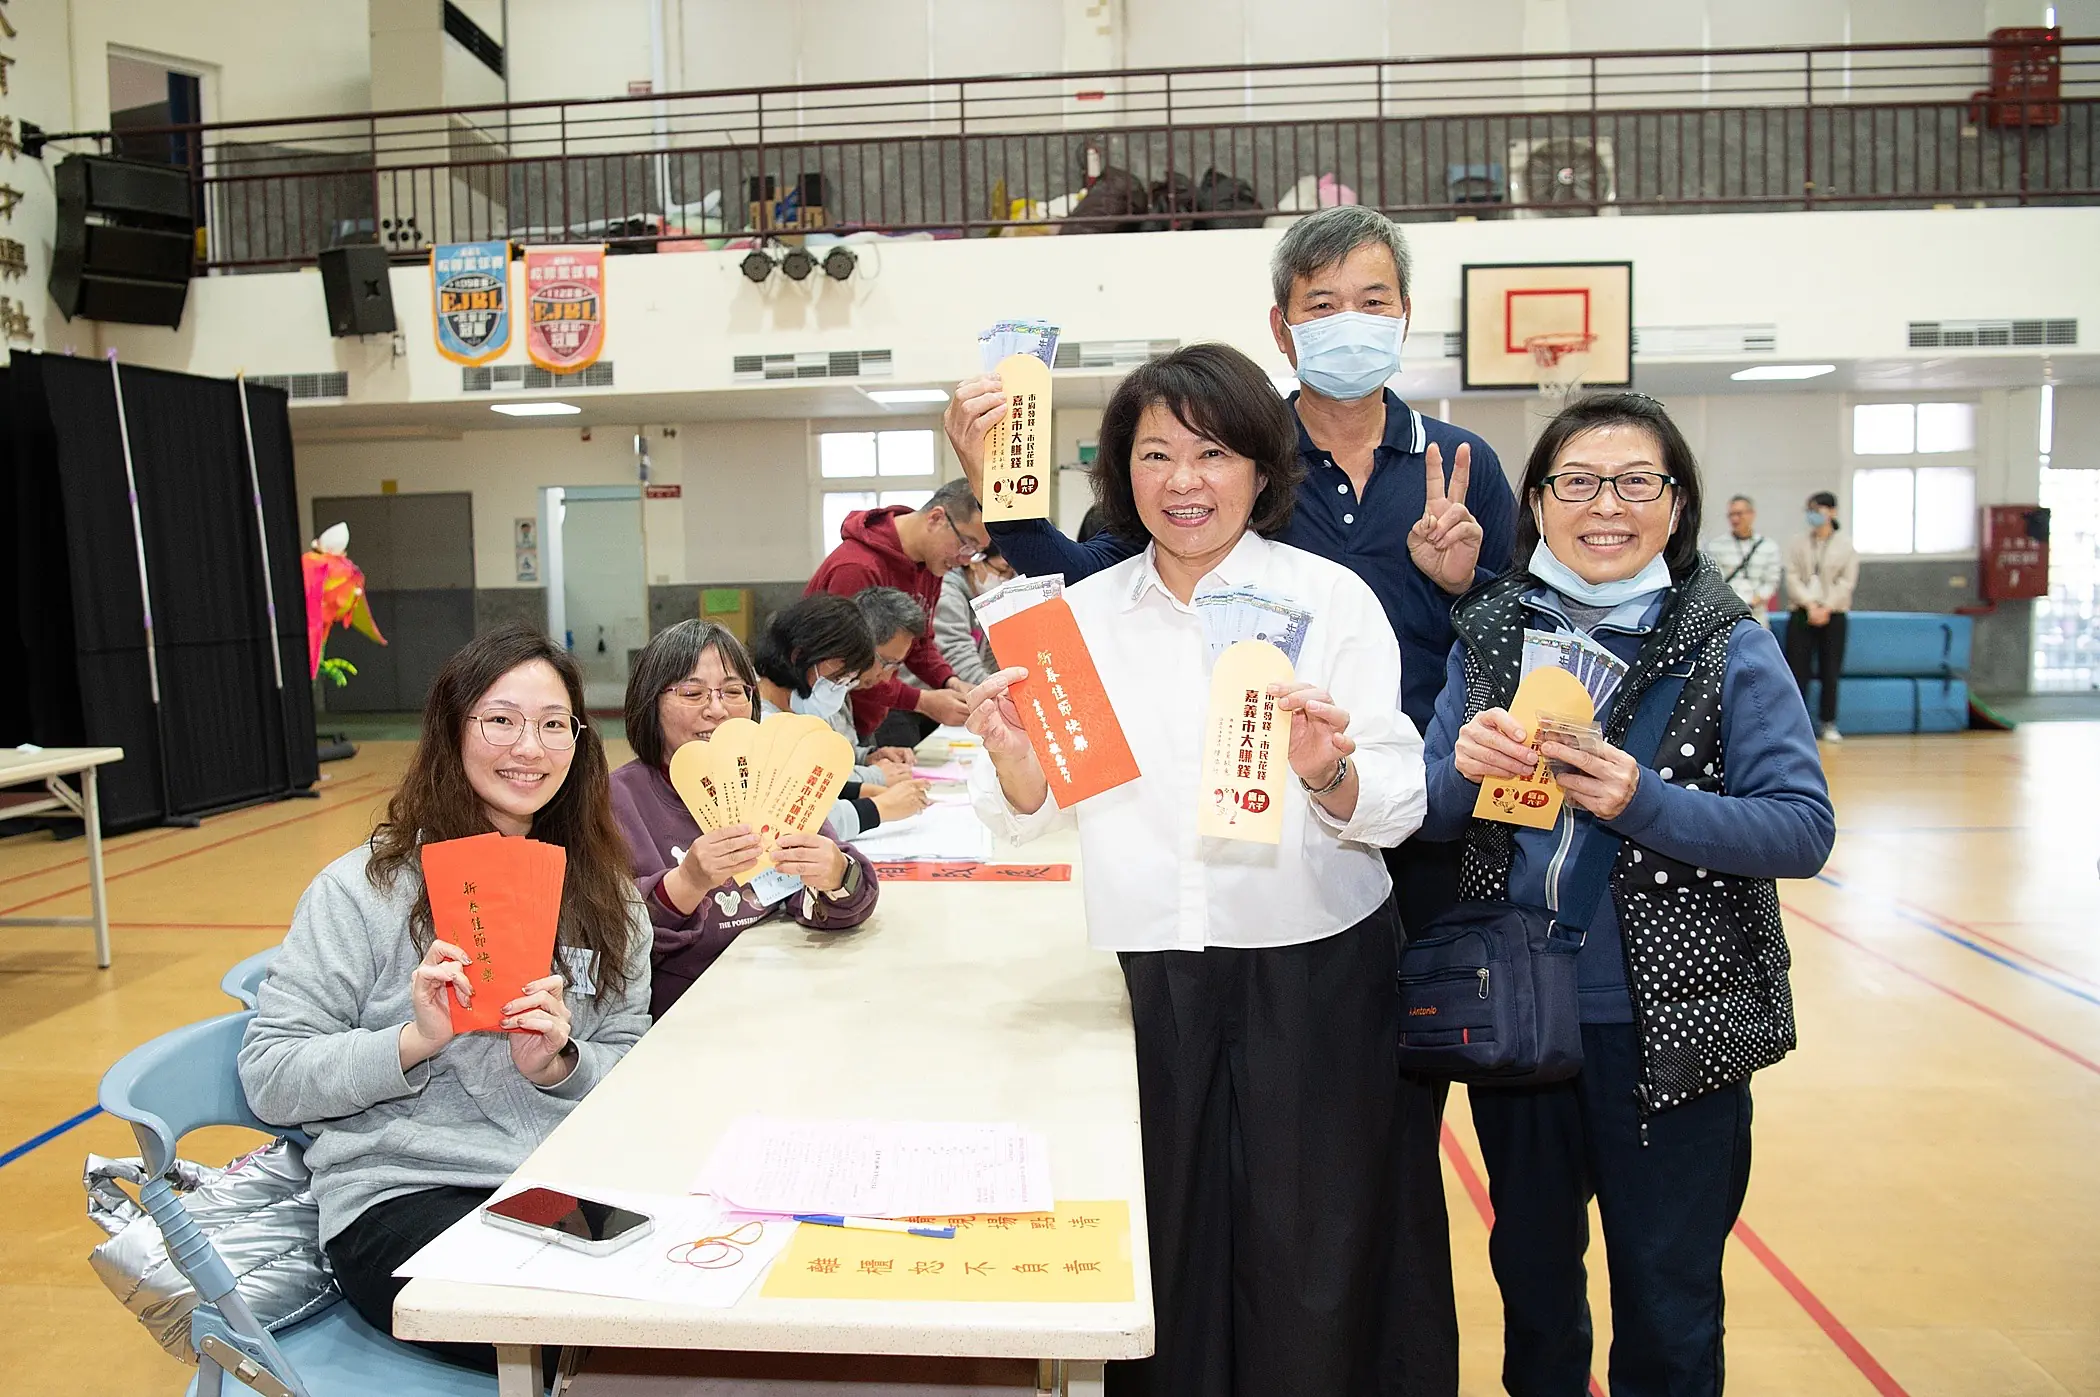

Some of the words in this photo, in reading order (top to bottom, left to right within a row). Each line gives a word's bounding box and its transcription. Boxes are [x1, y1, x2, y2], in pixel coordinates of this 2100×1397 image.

[441, 289, 503, 312] EJBL
[1010, 395, 1024, 469] 嘉義市大賺錢
[1036, 650, 1088, 752] 新春佳節快樂
[1237, 690, 1259, 779] 嘉義市大賺錢
[784, 765, 824, 826] 嘉義市大賺錢
[463, 881, 494, 983] 新春佳節快樂
[806, 1256, 1102, 1277] 離櫃恕不負責
